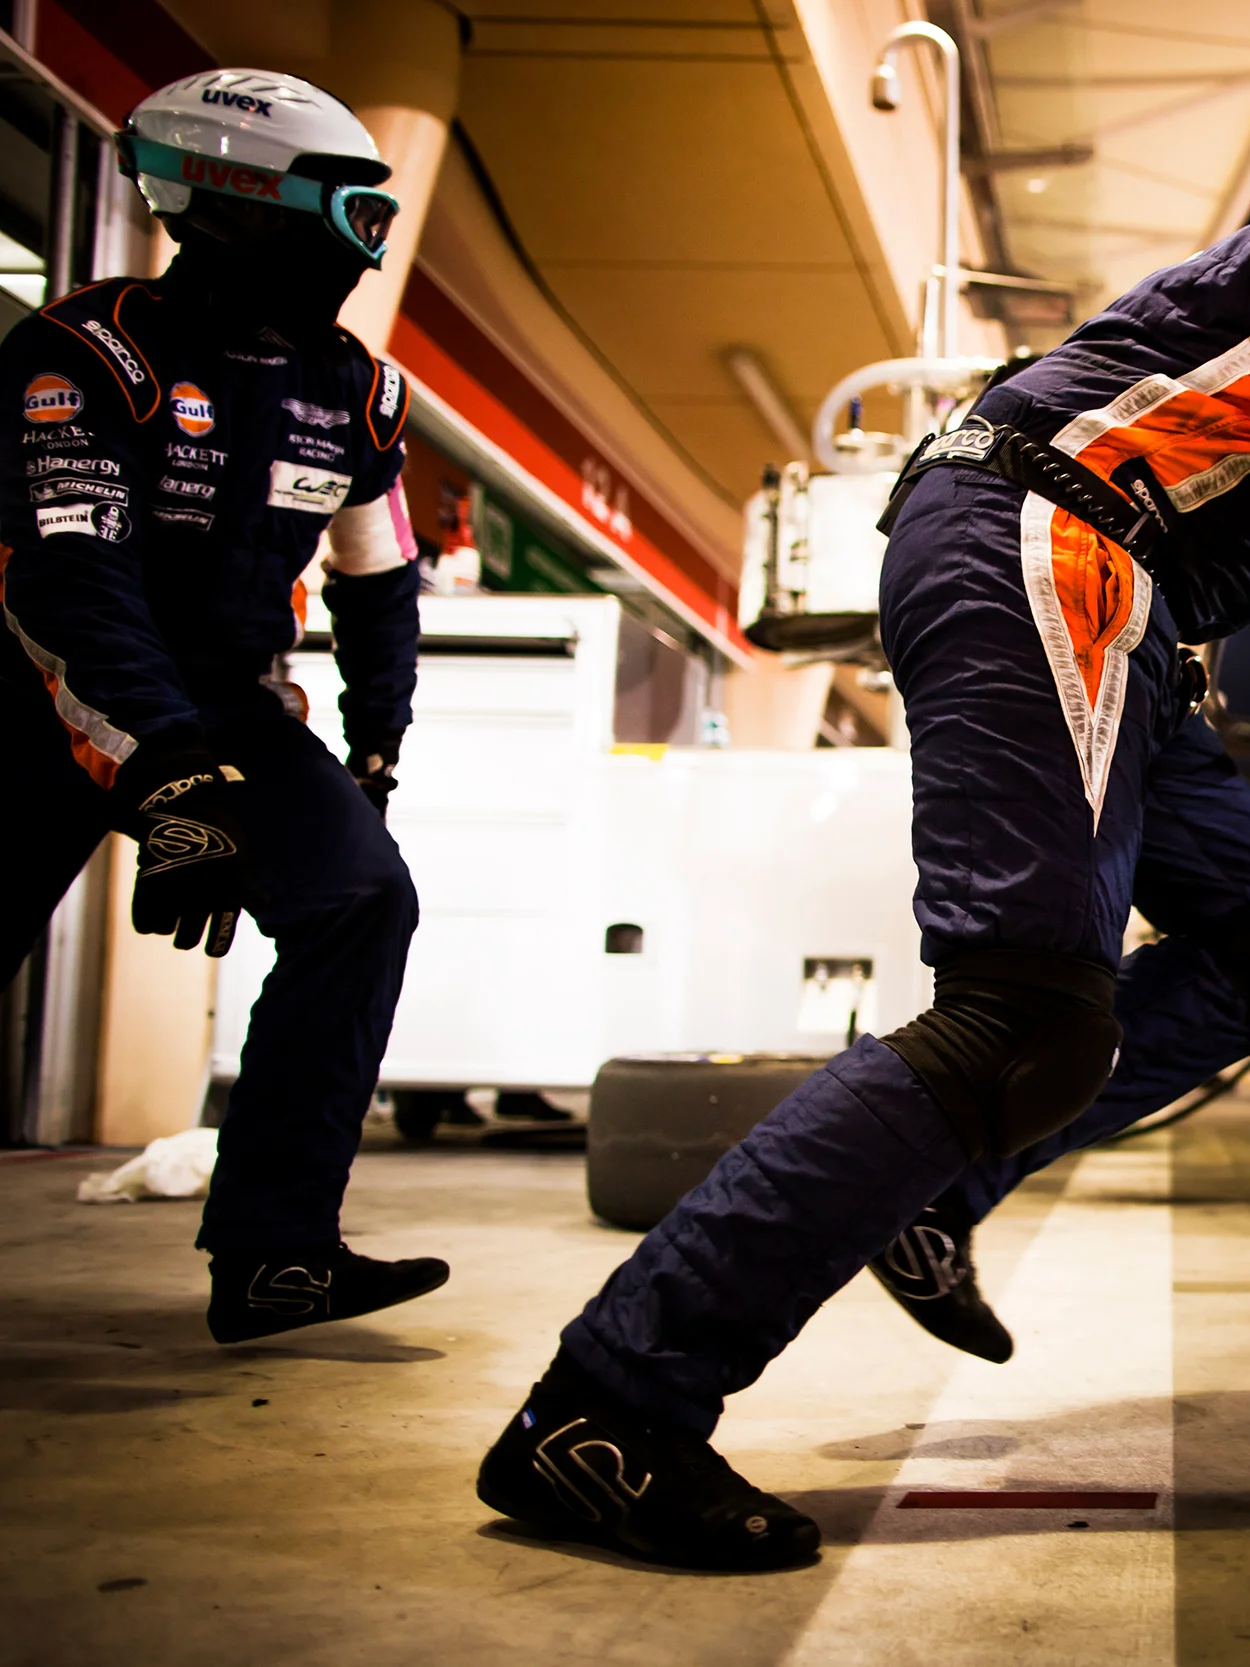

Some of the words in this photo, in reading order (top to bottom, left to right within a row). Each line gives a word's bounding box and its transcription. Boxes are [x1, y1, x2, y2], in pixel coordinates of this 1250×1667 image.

[201, 88, 273, 118] uvex
[181, 155, 283, 200] uvex
[82, 320, 145, 384] sparco
[25, 391, 80, 410] Gulf
[168, 398, 214, 419] Gulf
[37, 455, 120, 476] Hanergy
[57, 483, 126, 499] MICHELIN
[293, 476, 349, 497] WEC
[39, 513, 90, 528] BILSTEIN
